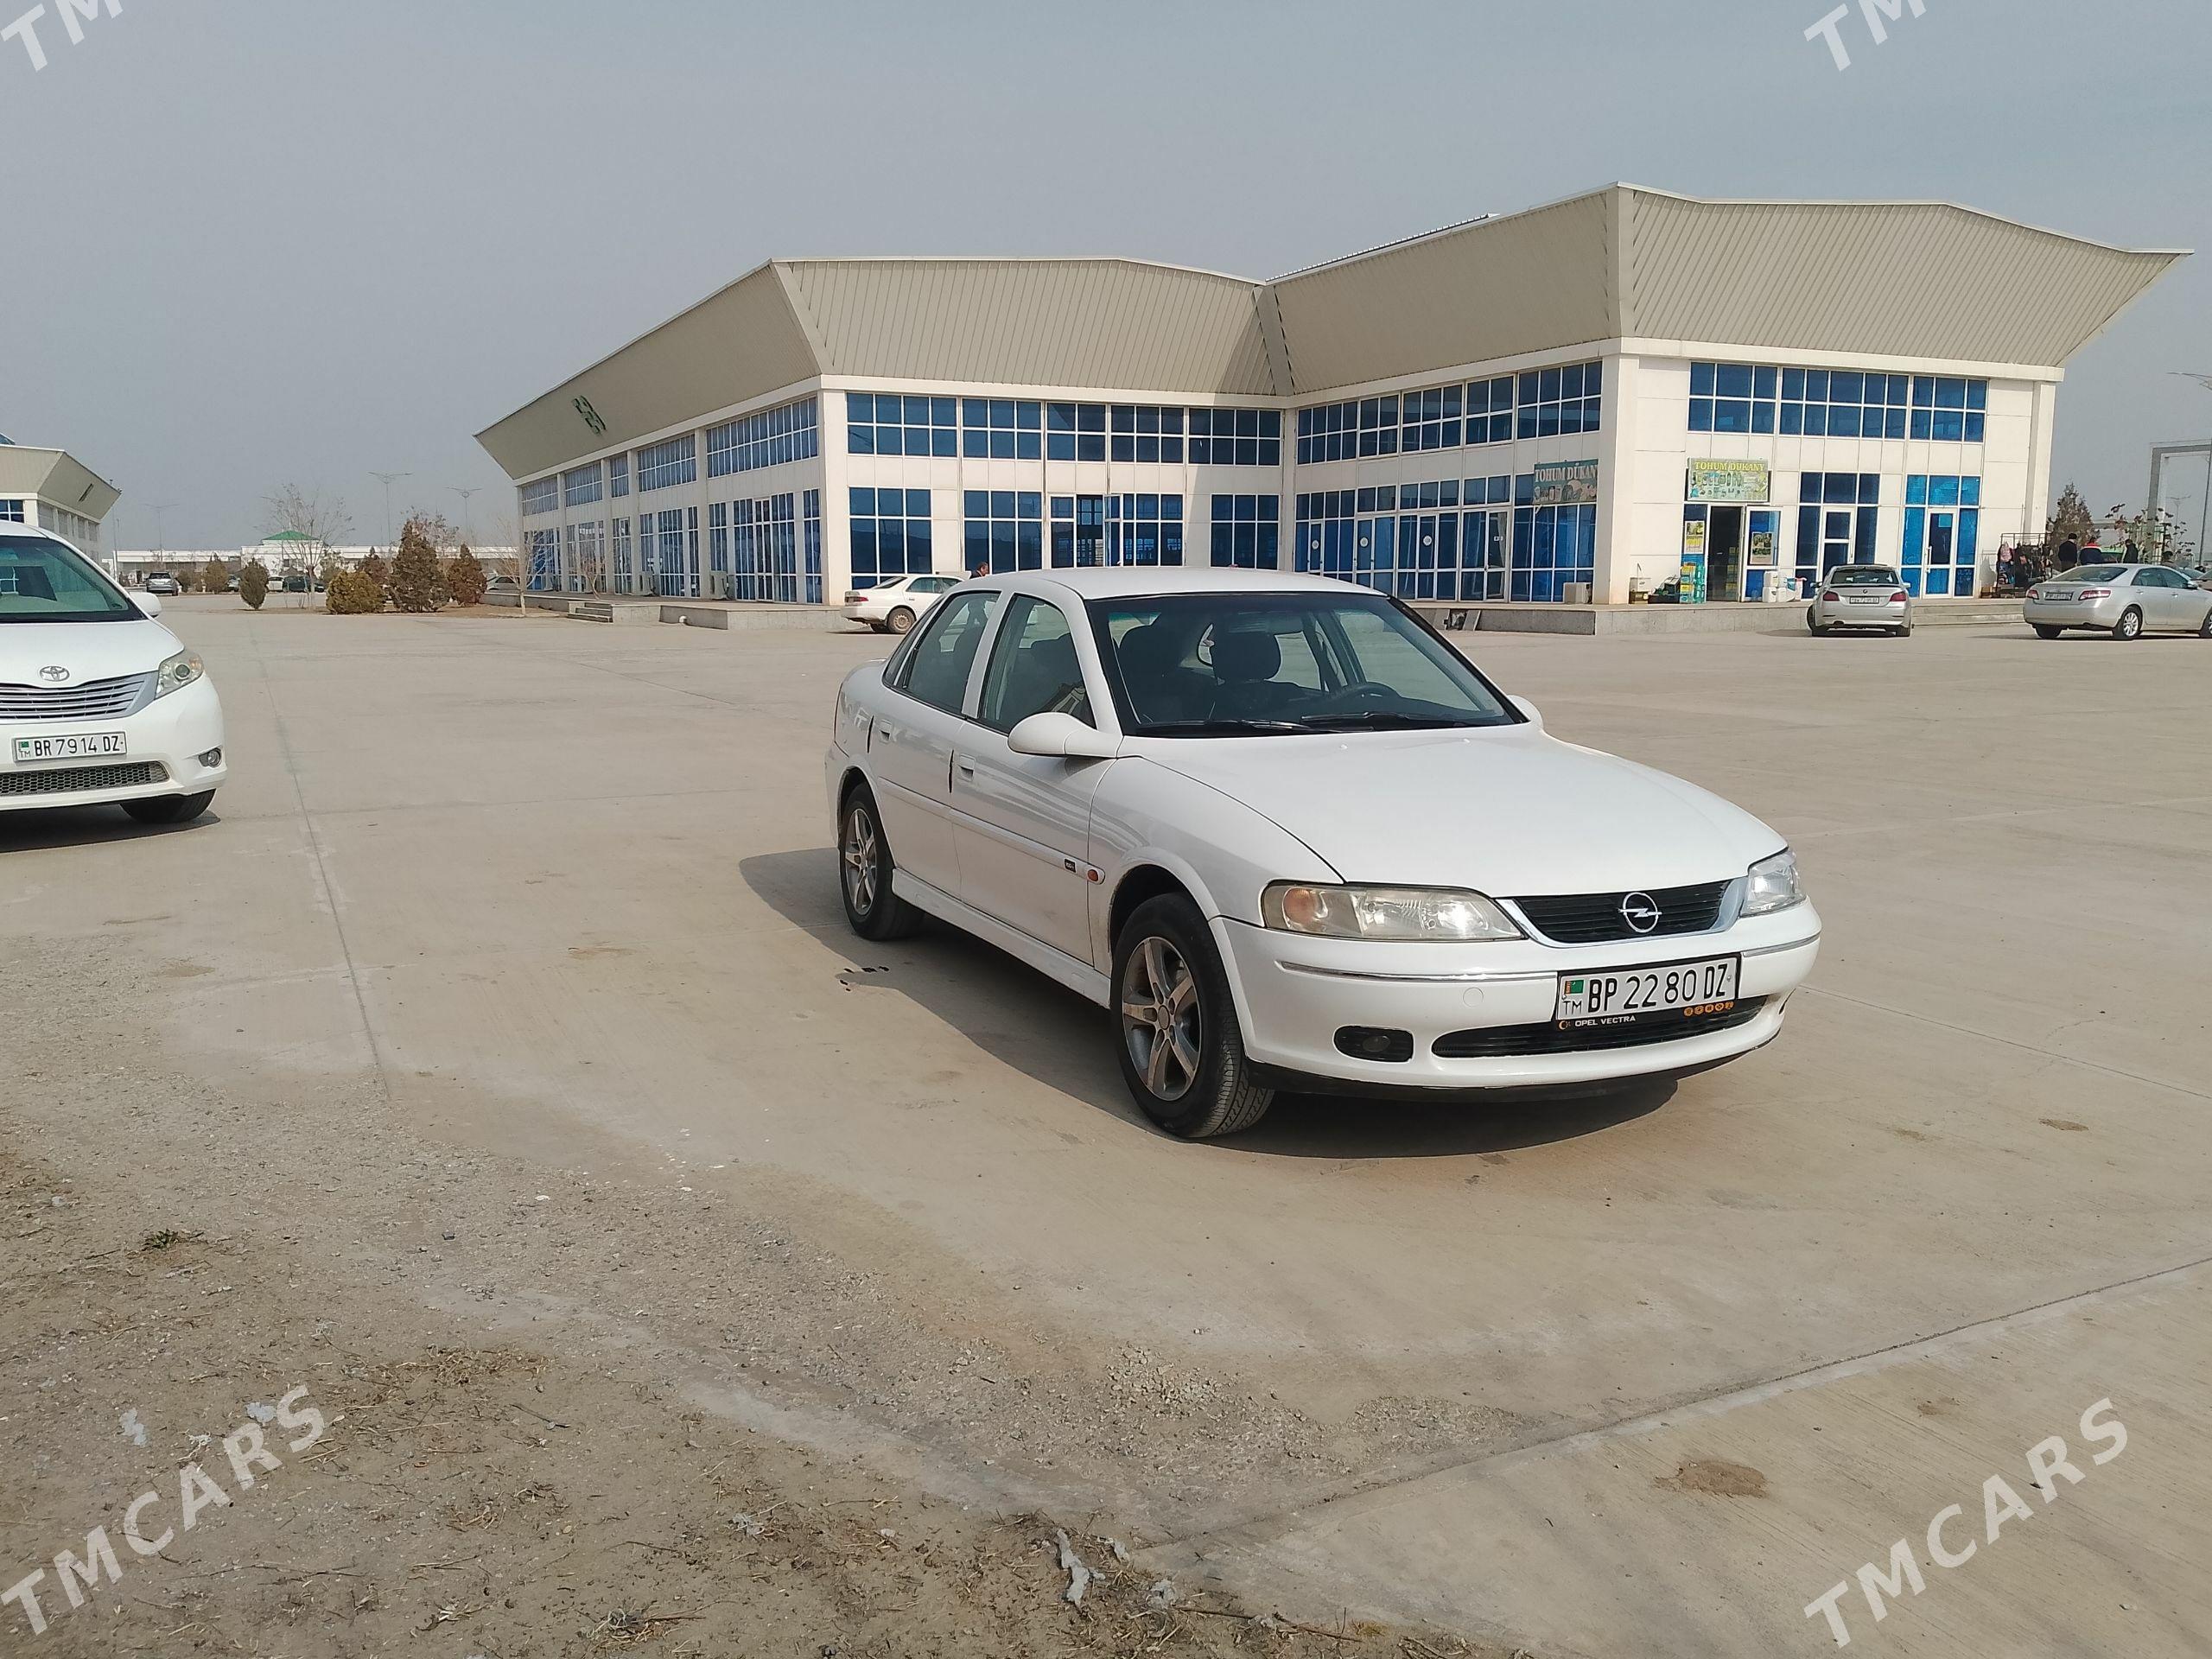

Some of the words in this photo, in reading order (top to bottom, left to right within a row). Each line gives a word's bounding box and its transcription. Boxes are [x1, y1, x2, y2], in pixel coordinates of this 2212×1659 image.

[1695, 461, 1727, 471] TOHUM
[1535, 467, 1566, 482] TOHUM
[34, 740, 52, 757] BR
[102, 735, 120, 752] DZ
[1588, 978, 1618, 1012] BP
[1703, 963, 1728, 1000] DZ
[1562, 1000, 1582, 1015] TM
[1600, 1014, 1637, 1025] VECTRA
